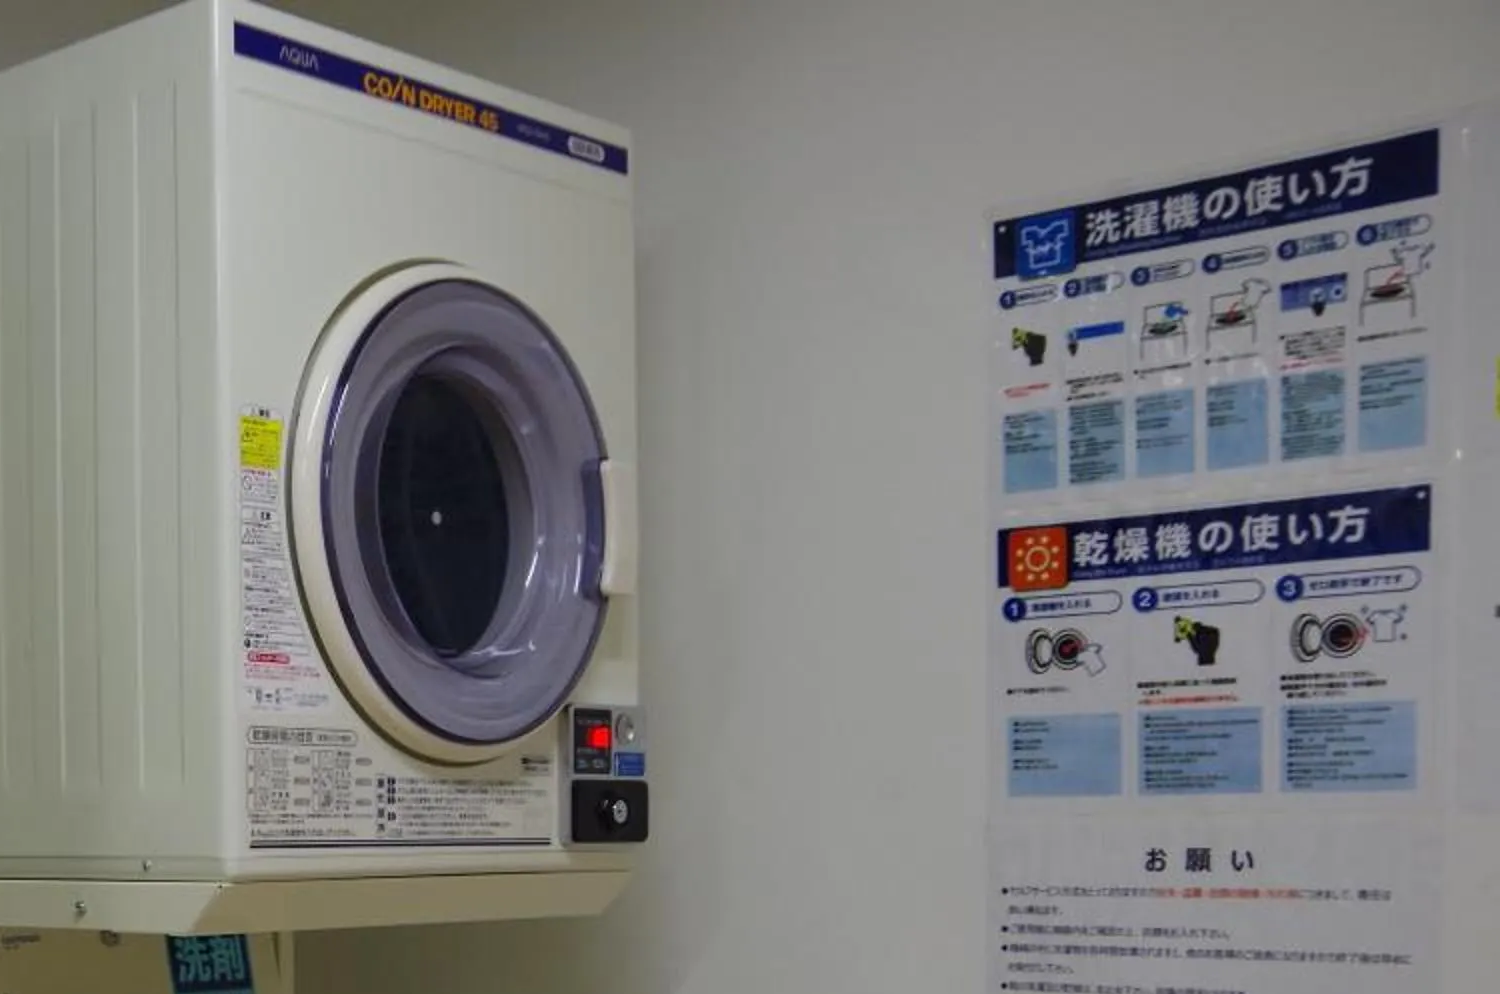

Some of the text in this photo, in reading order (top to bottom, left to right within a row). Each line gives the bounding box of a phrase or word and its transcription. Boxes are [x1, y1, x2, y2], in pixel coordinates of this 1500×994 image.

[280, 45, 318, 71] AQUA
[420, 89, 475, 124] DRYER
[479, 108, 499, 133] 45
[1085, 156, 1374, 247] 洗濯機の使い方
[1072, 506, 1370, 568] 乾燥機の使い方
[1144, 848, 1255, 873] お願い
[175, 936, 245, 982] 洗剤
